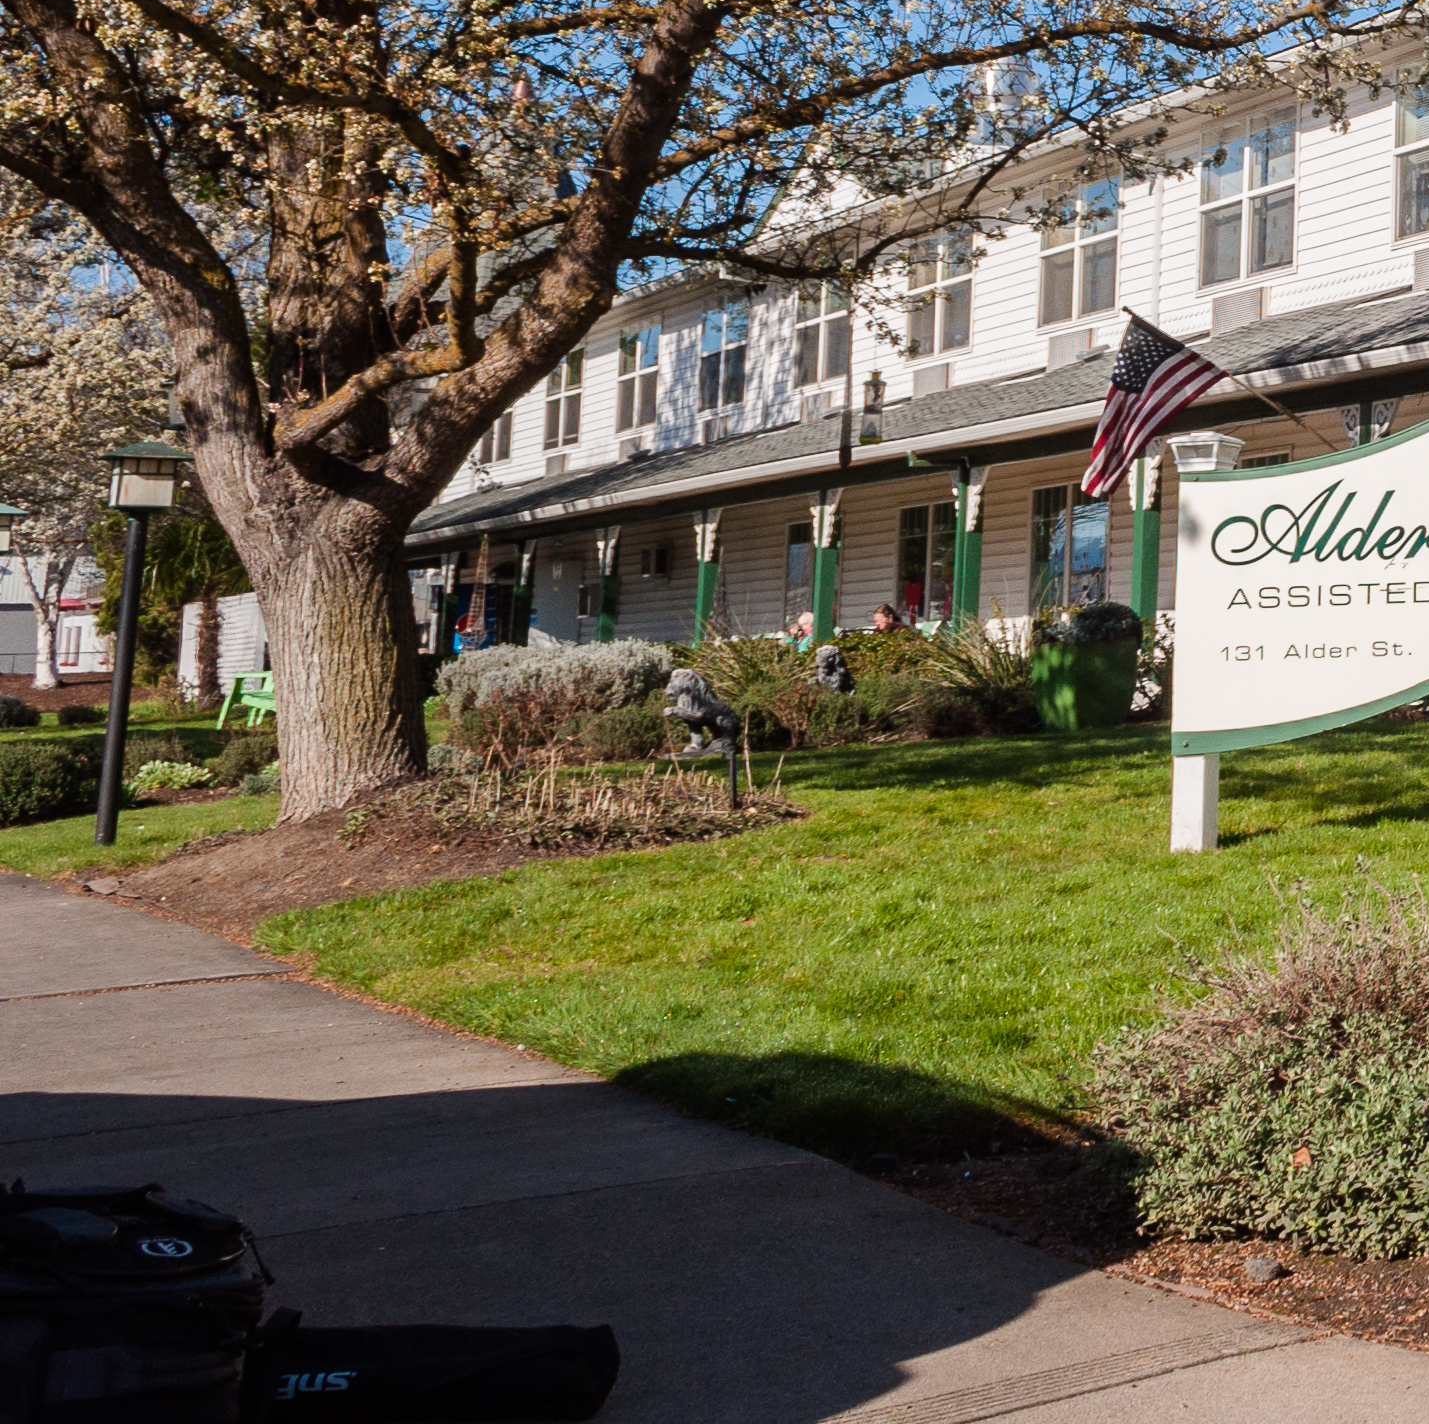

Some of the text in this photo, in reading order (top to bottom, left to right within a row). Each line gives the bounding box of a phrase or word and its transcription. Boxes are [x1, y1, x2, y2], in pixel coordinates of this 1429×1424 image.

[1220, 640, 1413, 662] 131 Alder St.
